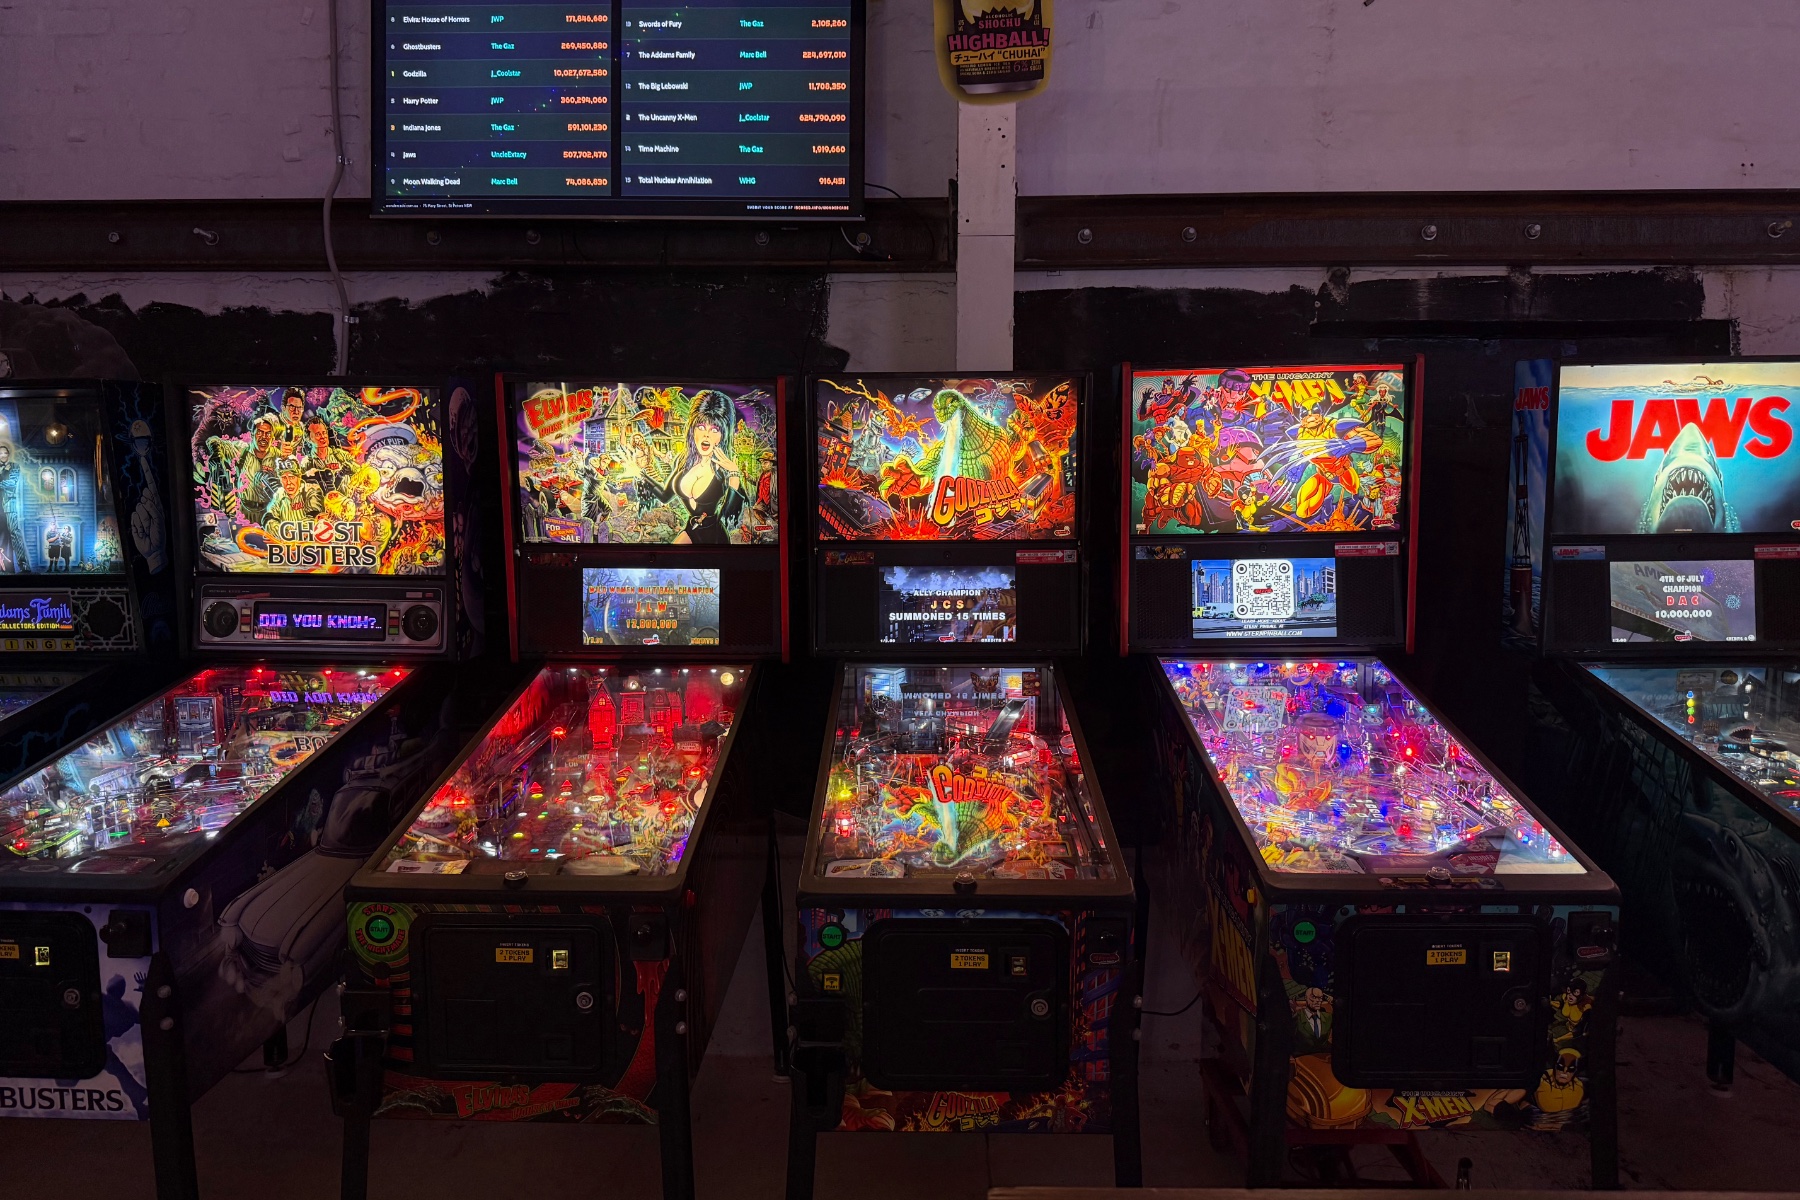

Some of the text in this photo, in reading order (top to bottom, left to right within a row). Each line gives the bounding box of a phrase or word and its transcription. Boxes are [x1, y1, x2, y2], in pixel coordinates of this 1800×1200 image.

[662, 20, 668, 28] of
[979, 18, 1021, 28] SHOCHU
[948, 29, 1049, 51] HIGHBALL!
[676, 52, 695, 60] Family
[740, 51, 767, 59] Marc Bell
[954, 52, 995, 62] チューハイ
[651, 83, 660, 91] Big
[739, 83, 753, 91] JWP
[403, 97, 419, 105] Harry
[491, 97, 504, 105] JWP
[651, 114, 676, 122] Uncanny
[491, 151, 527, 159] UncleExtacy
[421, 178, 444, 187] Walking
[1515, 386, 1549, 411] JAWS
[1586, 396, 1793, 462] JAWS
[371, 440, 386, 452] STAY
[933, 476, 1019, 525] GODZILLA
[975, 499, 1021, 524] ゴジラ
[267, 544, 376, 566] BUSTERS
[931, 600, 964, 609] J C S
[1666, 596, 1698, 606] D A C
[636, 601, 667, 612] J L W
[1655, 610, 1712, 618] 10,000,000
[259, 614, 287, 627] DID
[293, 614, 322, 627] YOU
[362, 904, 396, 915] START
[355, 928, 405, 954] THE NIGHTMARE
[1, 1087, 124, 1111] BUSTERS
[927, 1091, 998, 1127] GODZILLA
[1393, 1096, 1473, 1129] X-MEN
[960, 1115, 999, 1131] ゴジラ
